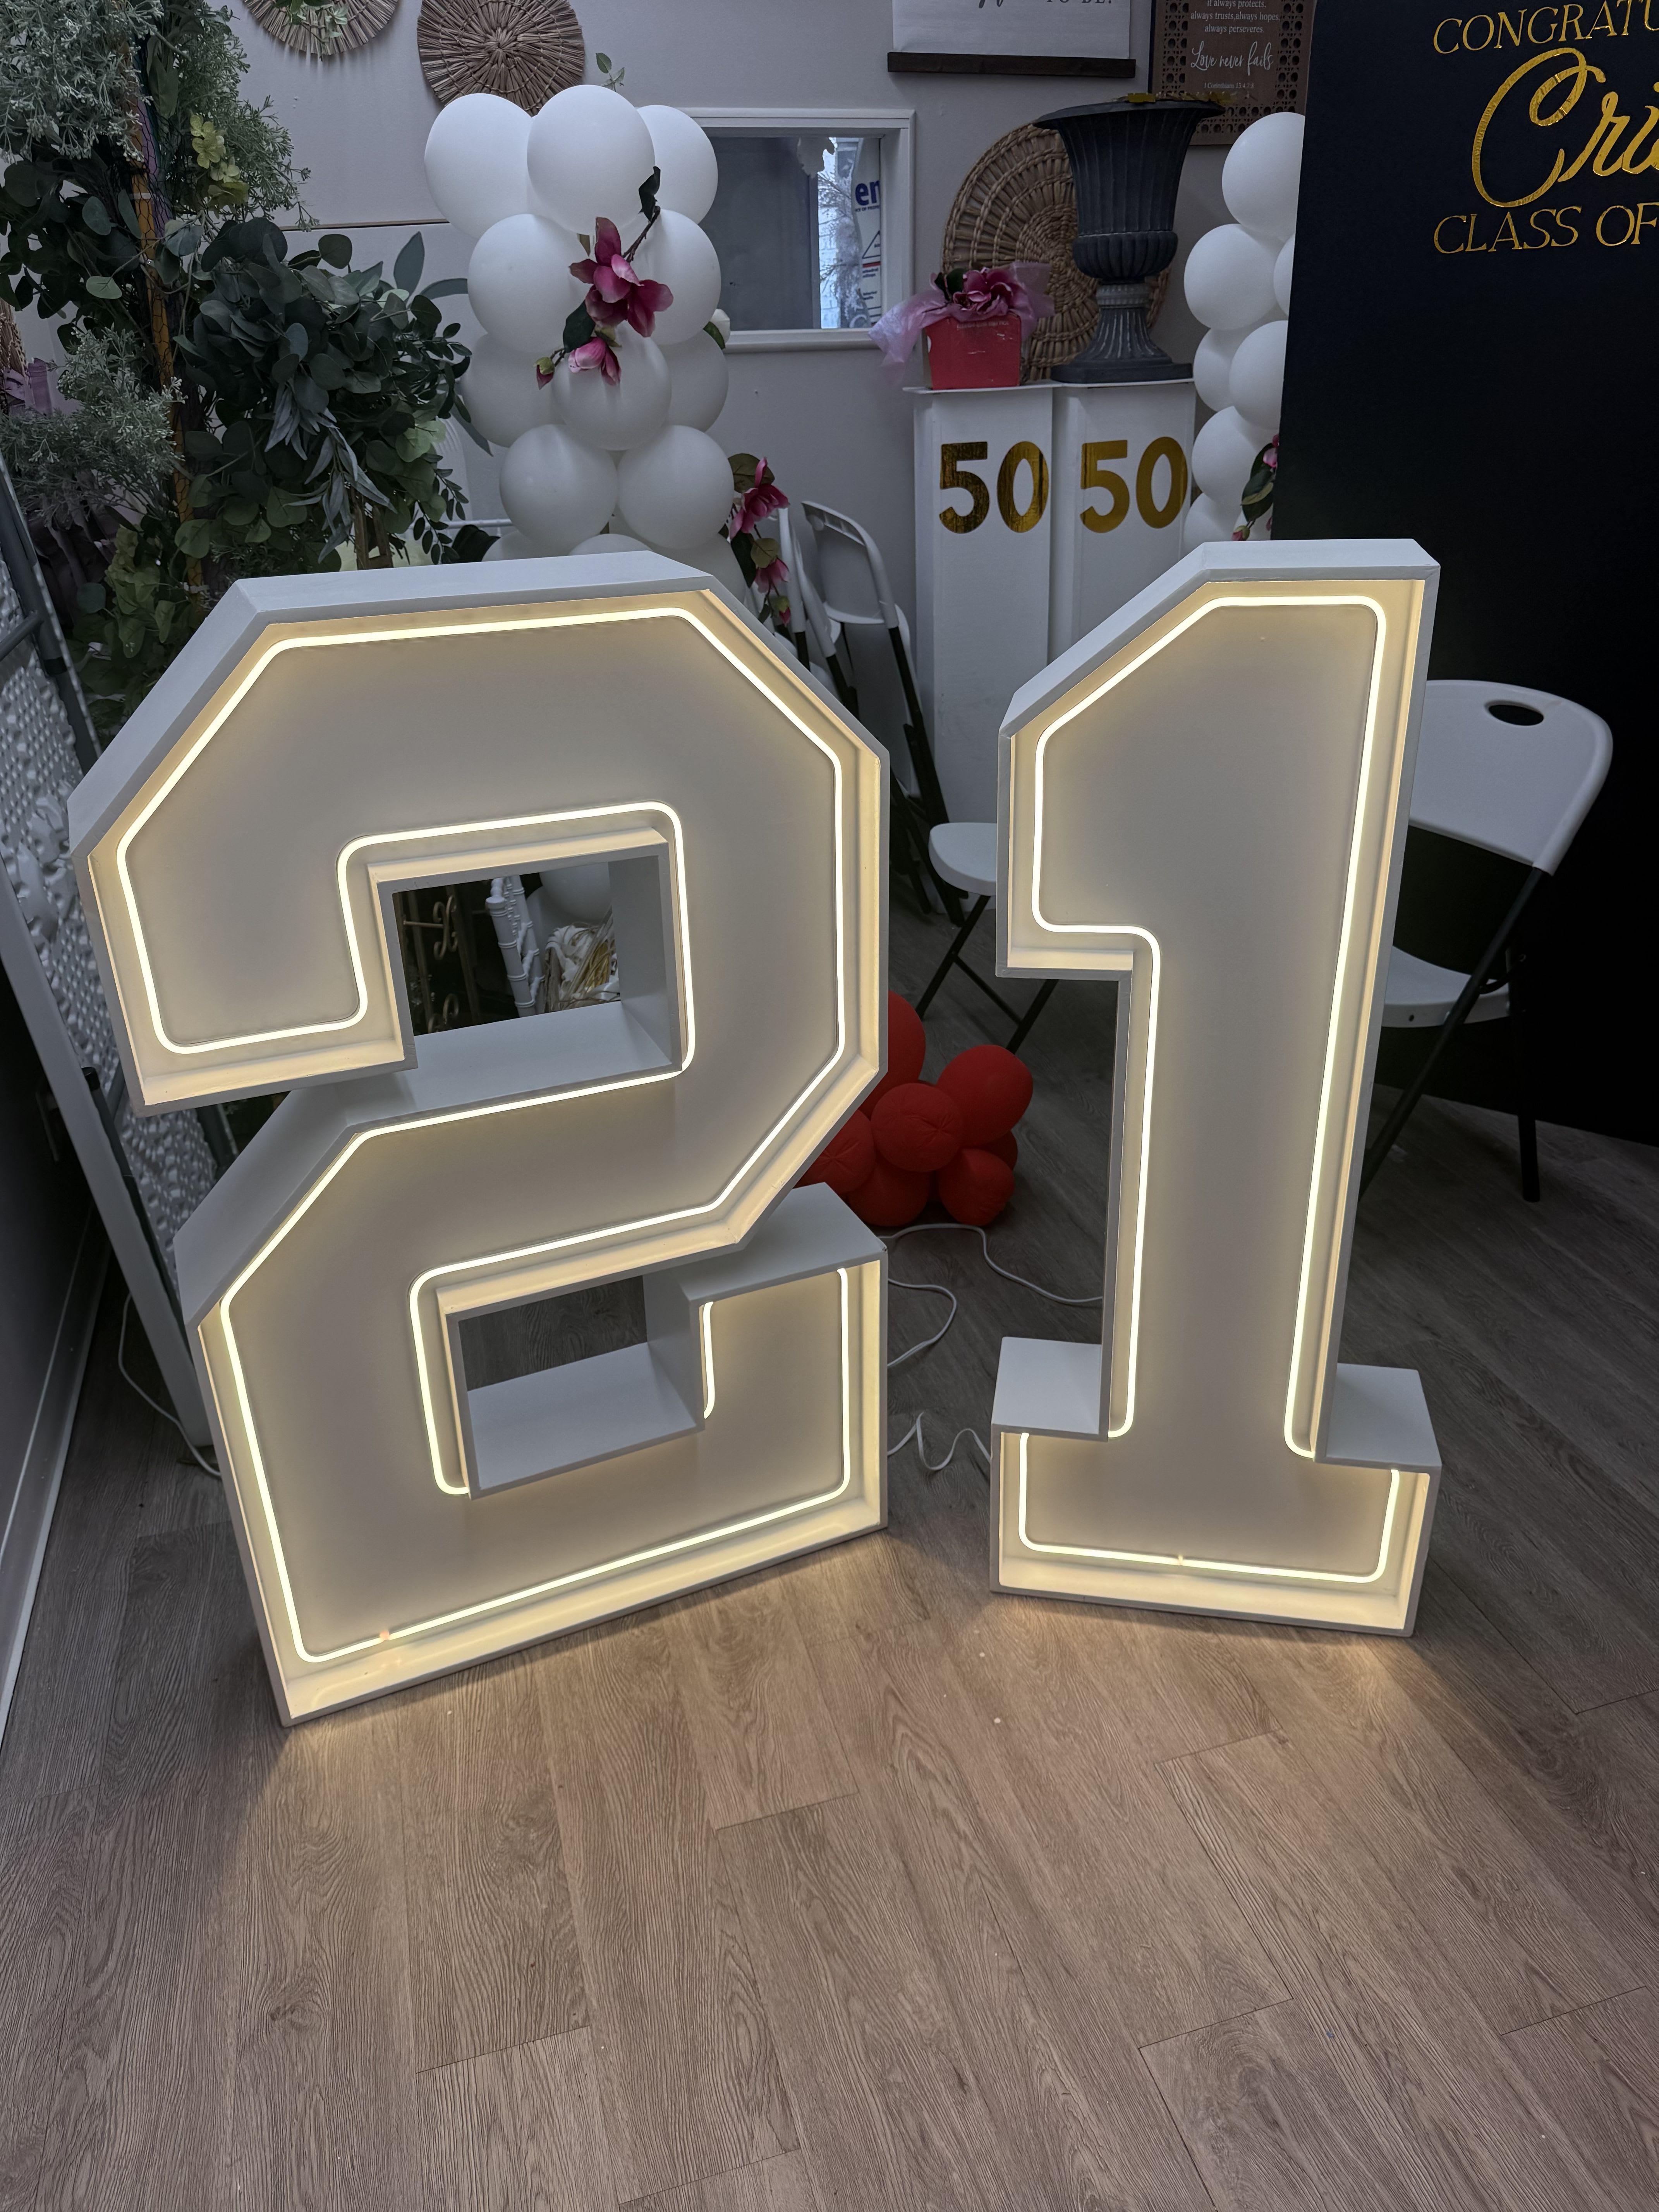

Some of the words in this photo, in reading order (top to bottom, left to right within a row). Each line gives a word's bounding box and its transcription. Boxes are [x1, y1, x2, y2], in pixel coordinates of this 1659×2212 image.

[1190, 11, 1213, 21] always
[1259, 12, 1280, 22] hopes,
[1214, 0, 1236, 9] always
[1205, 24, 1227, 34] always
[1229, 26, 1264, 34] perseveres.
[1190, 40, 1218, 71] Love
[1219, 55, 1244, 69] never
[1247, 41, 1273, 76] fails
[1434, 206, 1582, 254] CLASS
[1596, 202, 1659, 246] OF
[939, 441, 1049, 534] 50
[1080, 436, 1188, 534] 50
